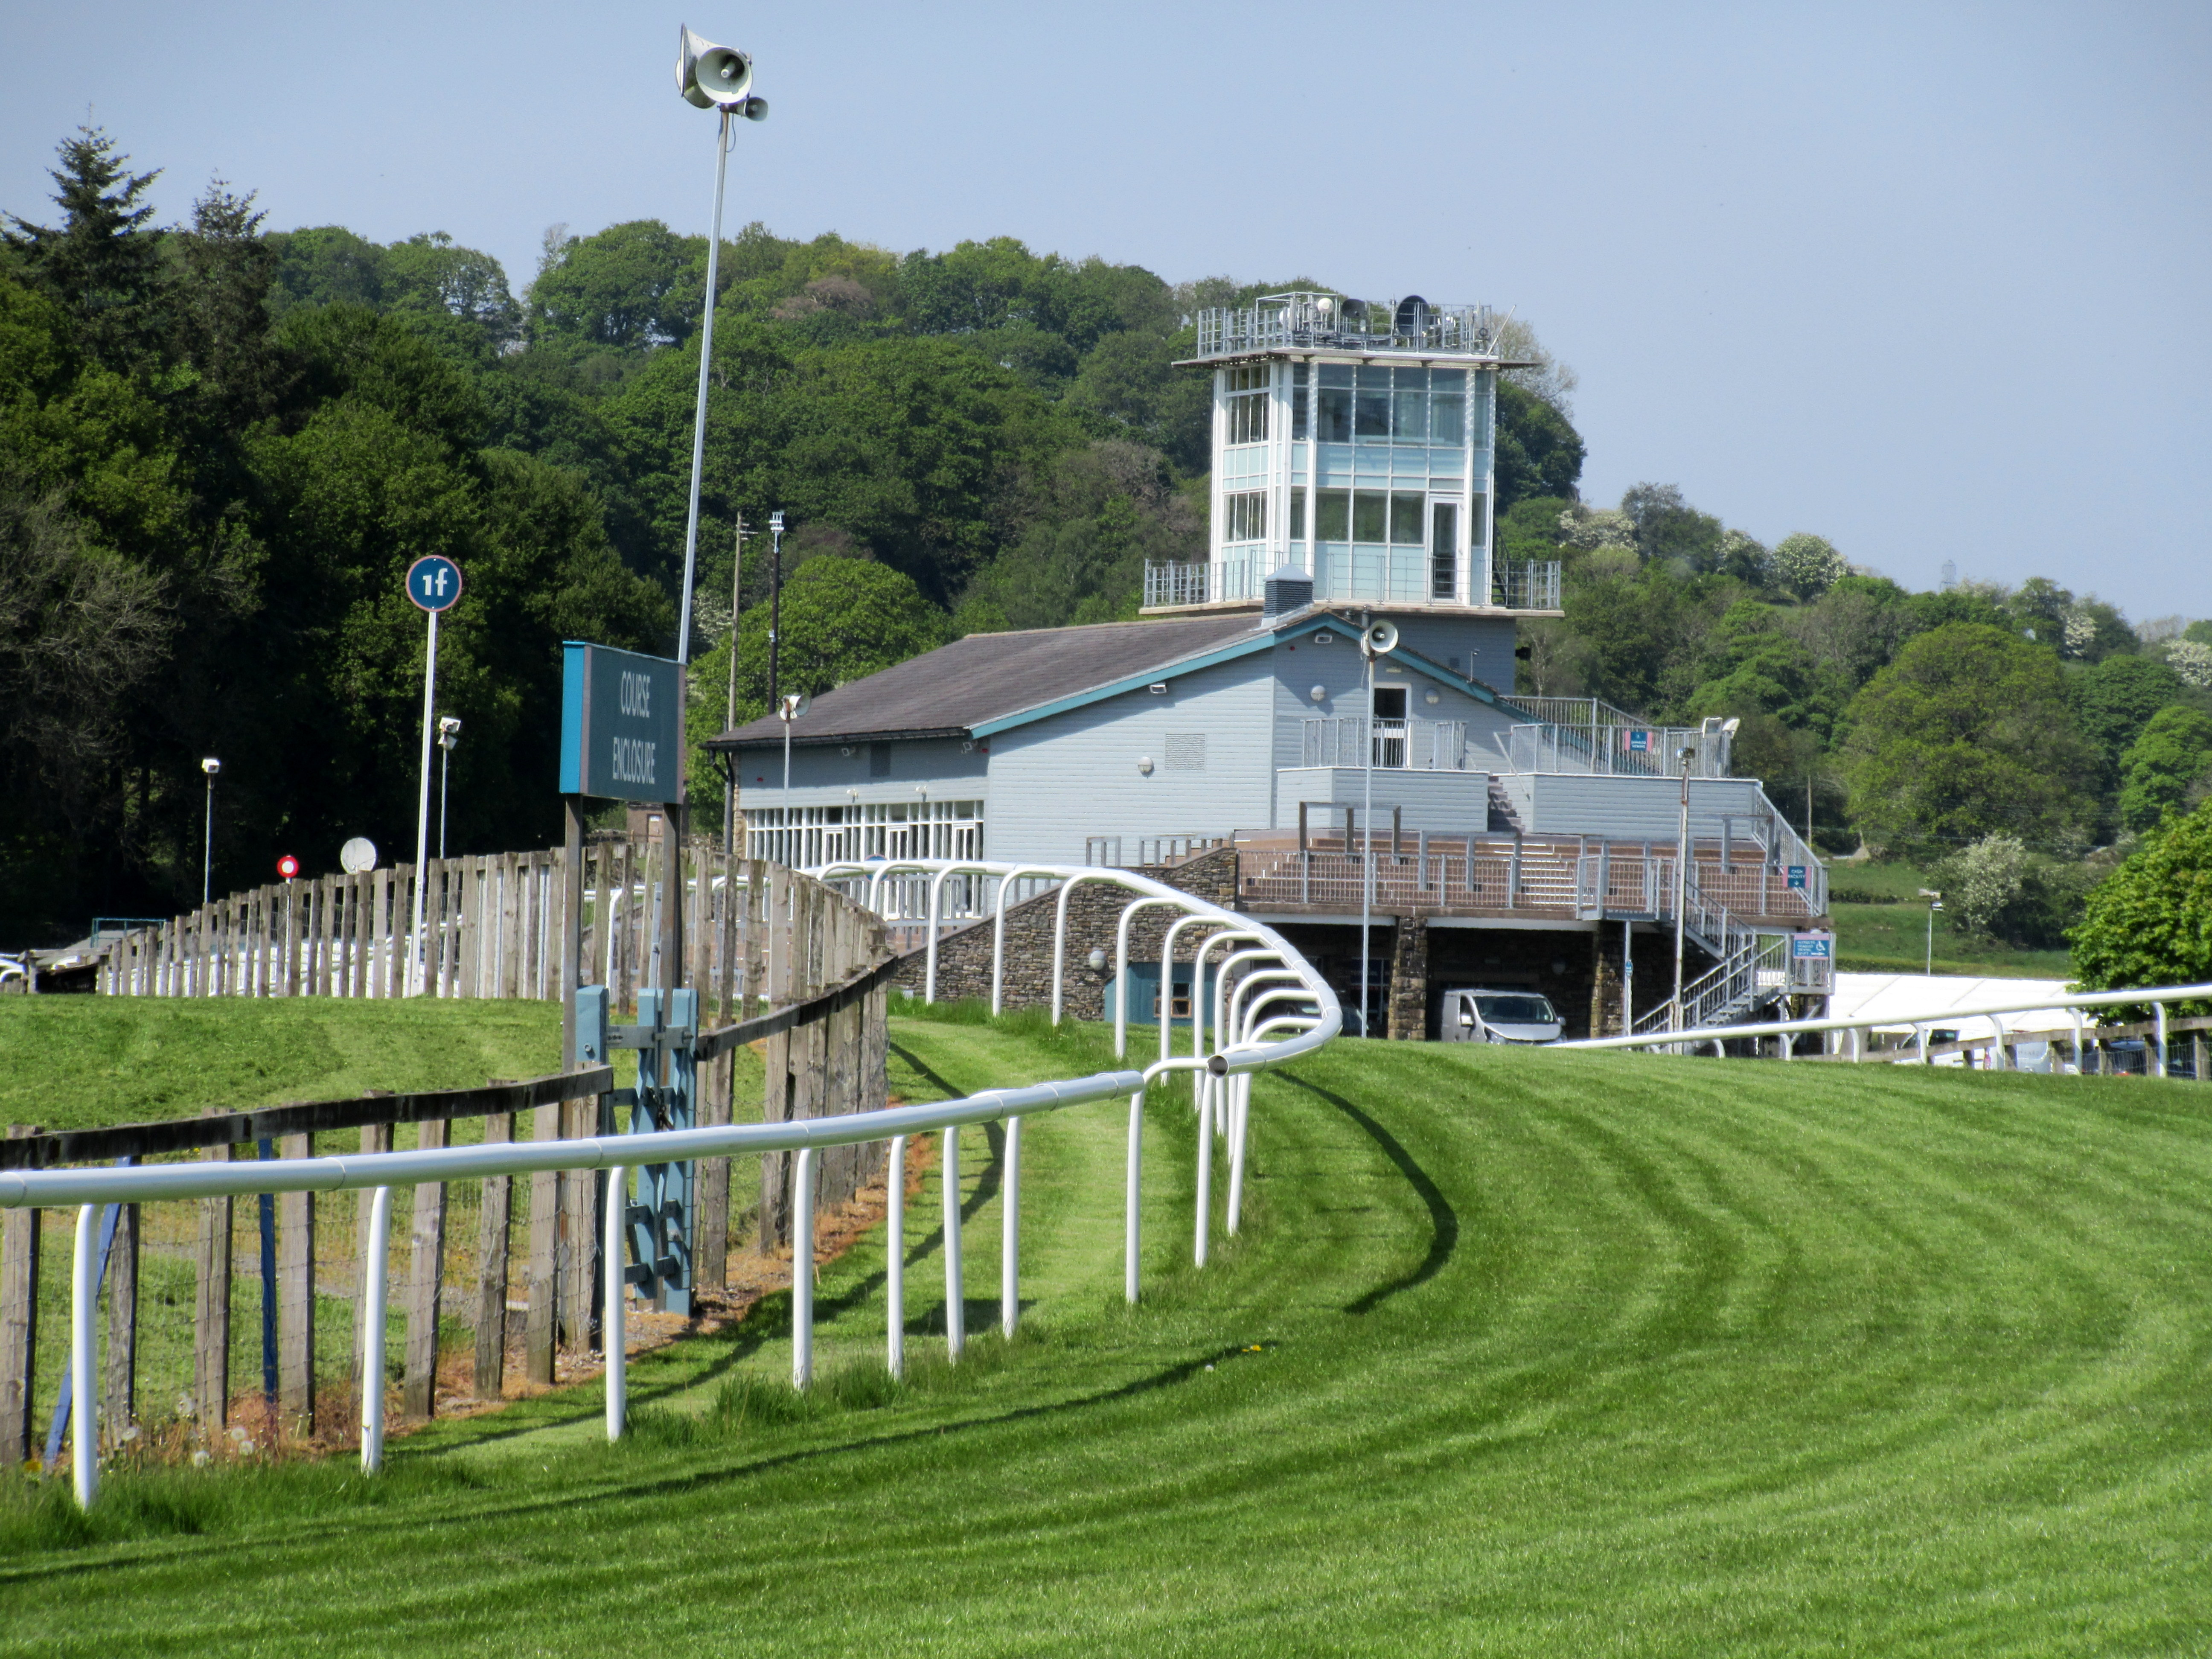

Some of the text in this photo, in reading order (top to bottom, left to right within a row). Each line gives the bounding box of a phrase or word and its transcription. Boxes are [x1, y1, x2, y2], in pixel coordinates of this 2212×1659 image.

[422, 568, 448, 596] 1f
[620, 670, 651, 718] COURSE
[612, 736, 656, 785] ENCLOSURE
